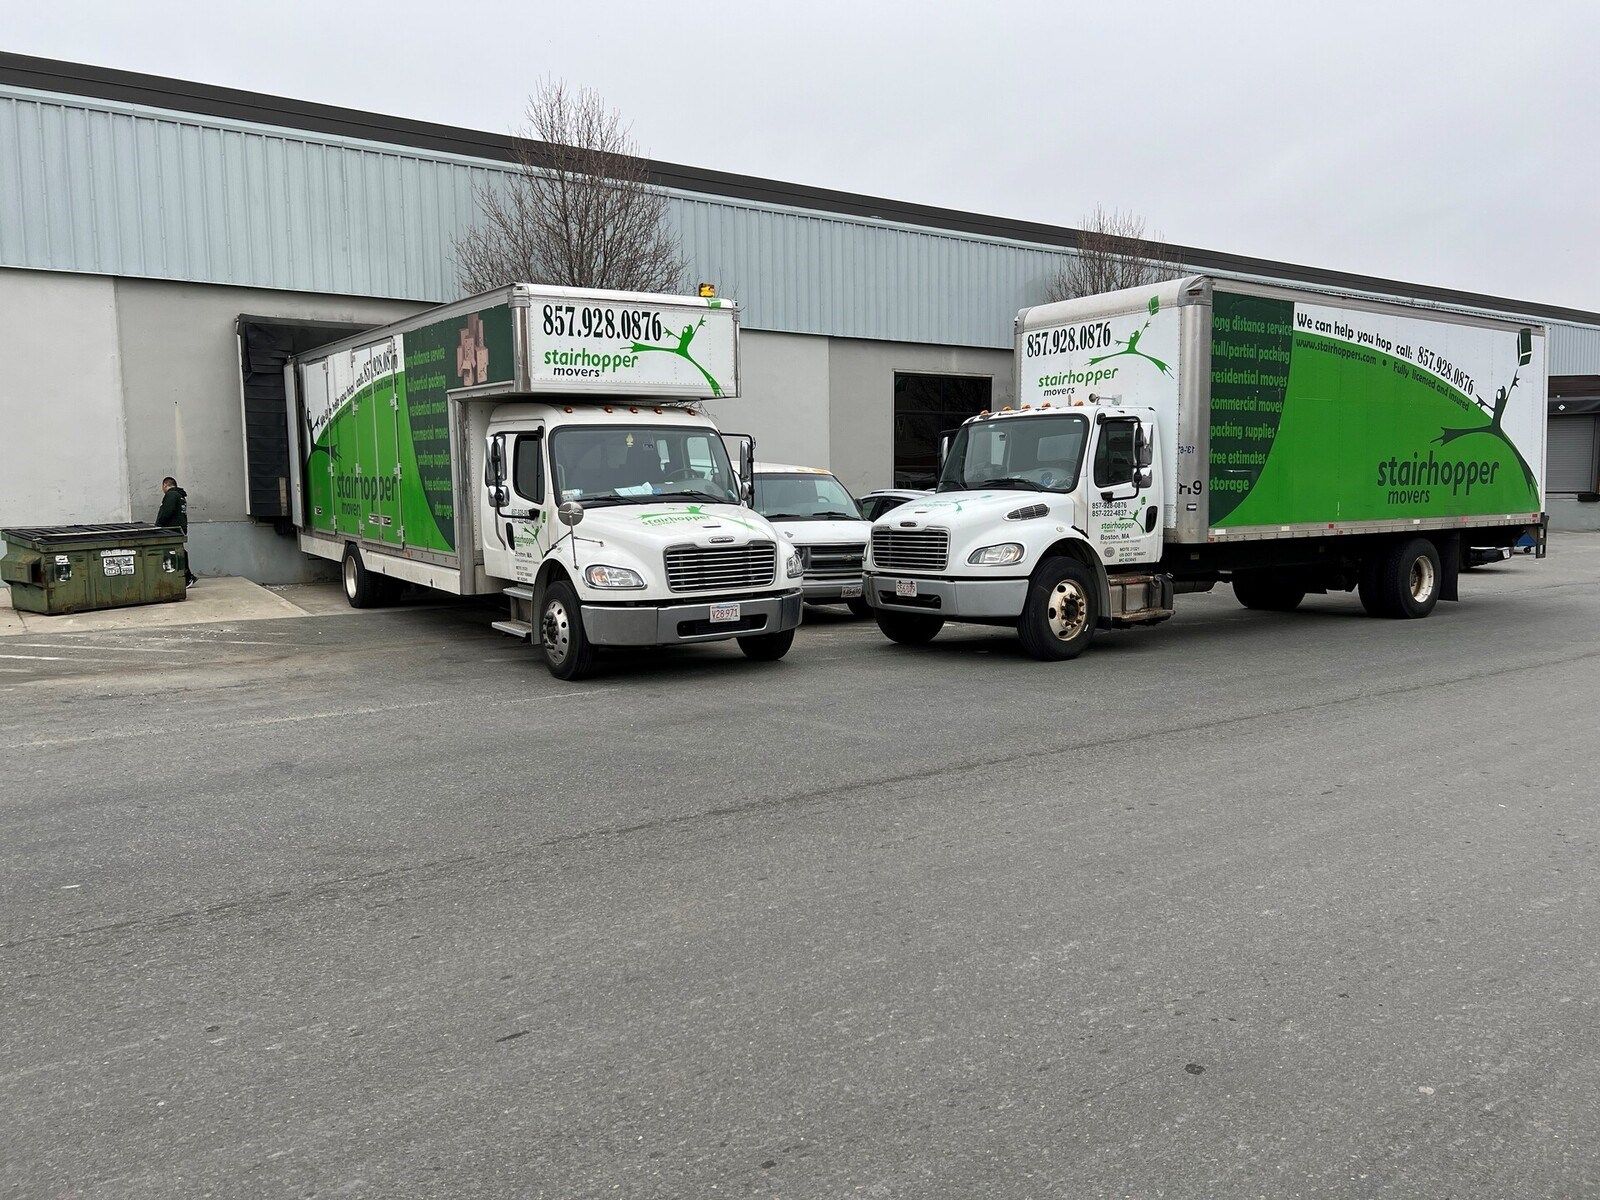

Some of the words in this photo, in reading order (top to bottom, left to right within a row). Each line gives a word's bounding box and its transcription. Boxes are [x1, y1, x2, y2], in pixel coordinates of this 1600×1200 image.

[542, 304, 662, 342] 857.928.0876
[1212, 313, 1230, 332] long
[1232, 315, 1265, 334] distance
[1267, 320, 1292, 336] service
[1026, 321, 1111, 358] 857.928.0876
[544, 347, 639, 373] stairhopper
[1212, 340, 1257, 360] full/partial
[1258, 346, 1290, 364] packing
[1296, 312, 1312, 329] We
[1315, 320, 1332, 334] can
[1334, 321, 1354, 340] help
[1357, 331, 1374, 344] you
[1376, 333, 1392, 352] hop
[1396, 344, 1412, 360] call:
[1418, 346, 1475, 396] 857.928.0876
[553, 366, 600, 378] movers
[1038, 368, 1119, 387] stairhopper
[1211, 368, 1259, 385] residential
[1260, 374, 1288, 388] moves
[1296, 338, 1376, 364] www.stairhoppers.com
[1393, 361, 1410, 378] Fully
[1412, 369, 1437, 390] licensed
[1436, 384, 1449, 396] and
[1448, 390, 1470, 412] insured
[1044, 387, 1075, 397] movers
[1210, 396, 1257, 411] commercial
[1258, 401, 1283, 413] moves
[1210, 420, 1243, 440] packing
[1246, 422, 1275, 441] supplies
[1210, 448, 1226, 464] free
[1228, 450, 1266, 465] estimates
[1377, 450, 1499, 496] stairhopper
[1209, 477, 1250, 493] storage
[1388, 488, 1430, 504] movers
[1092, 510, 1127, 518] 857-222-4837
[1101, 521, 1134, 531] stairhopper
